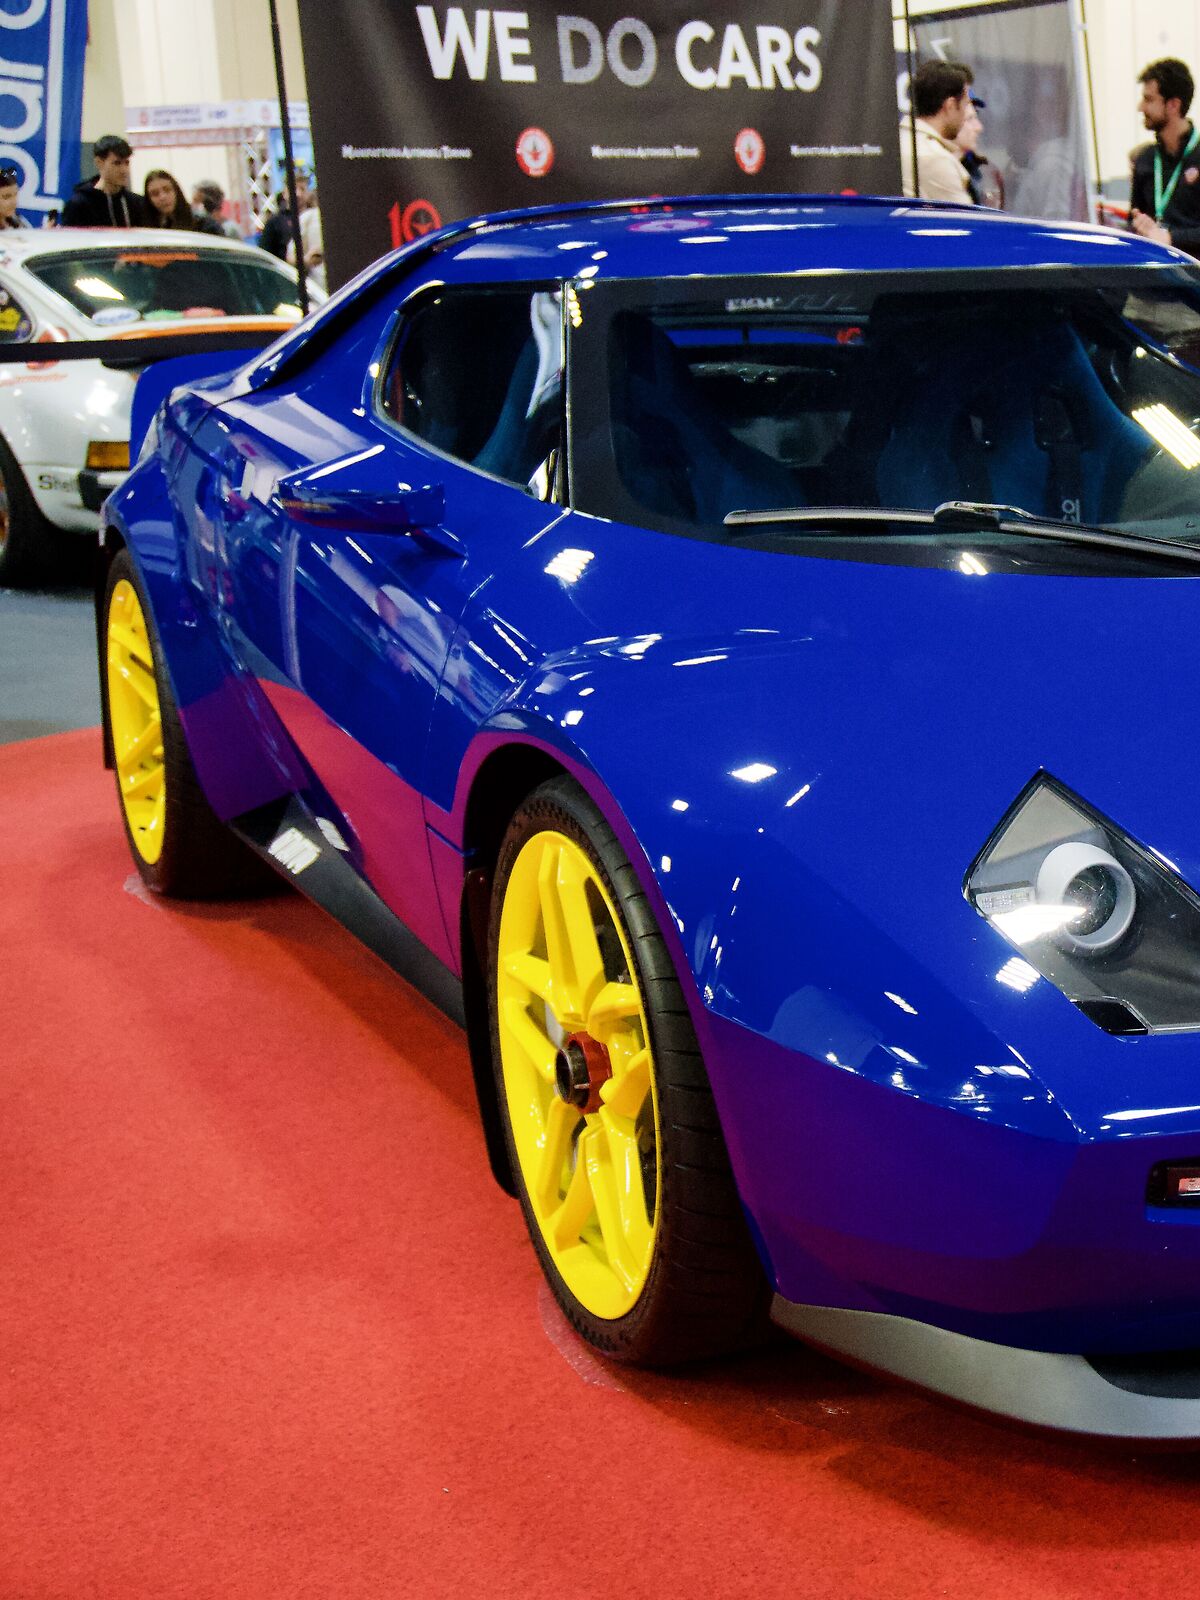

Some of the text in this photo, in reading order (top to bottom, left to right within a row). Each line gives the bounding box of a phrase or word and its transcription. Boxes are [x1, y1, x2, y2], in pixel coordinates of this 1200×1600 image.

[416, 5, 823, 92] WE DO CARS
